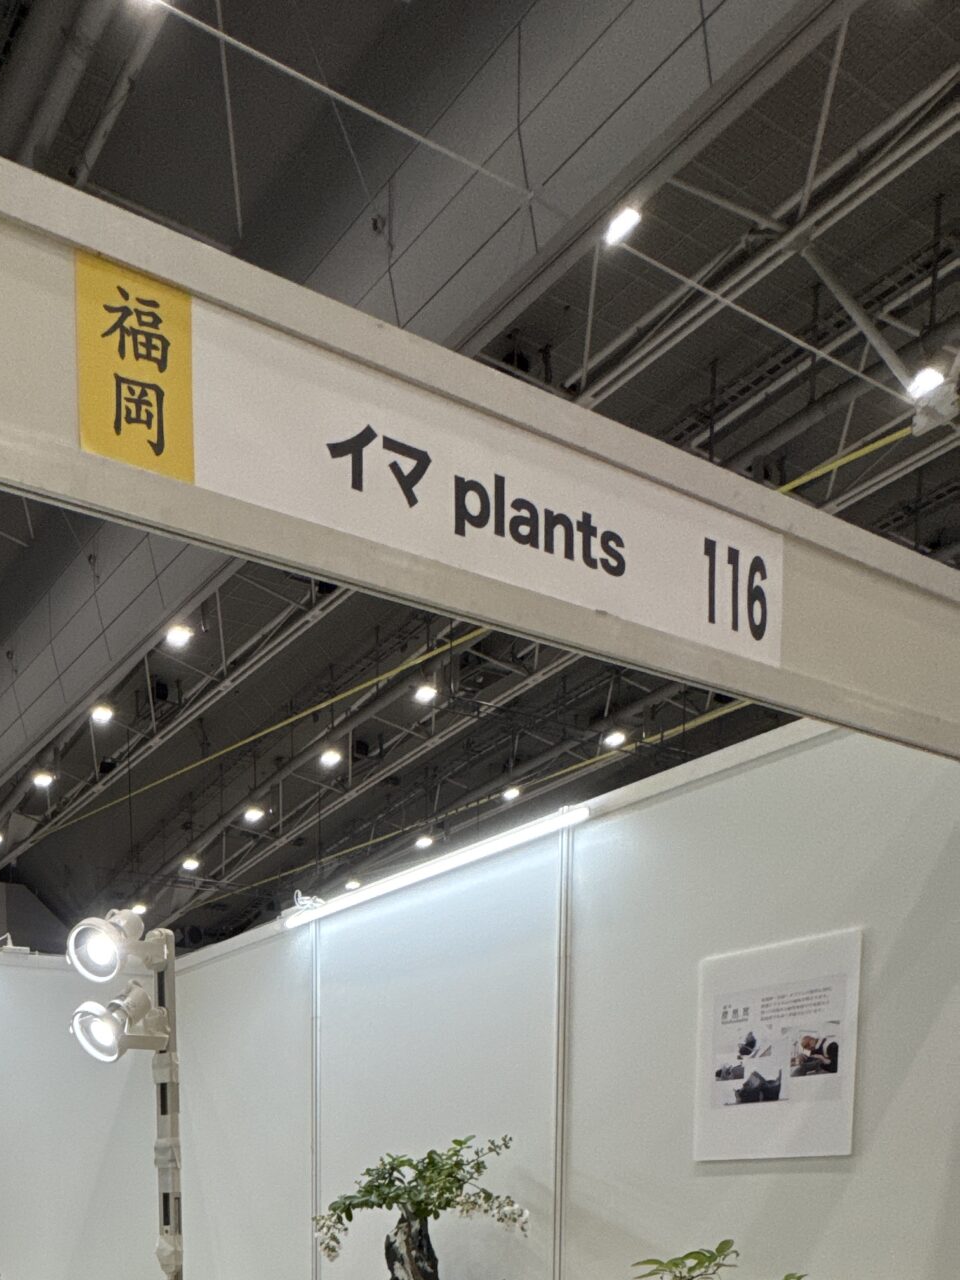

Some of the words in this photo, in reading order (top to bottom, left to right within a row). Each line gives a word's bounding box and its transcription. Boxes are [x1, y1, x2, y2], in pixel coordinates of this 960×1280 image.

[101, 285, 171, 457] 福岡
[326, 424, 432, 508] イマ
[454, 474, 626, 577] plants
[704, 537, 767, 641] 116
